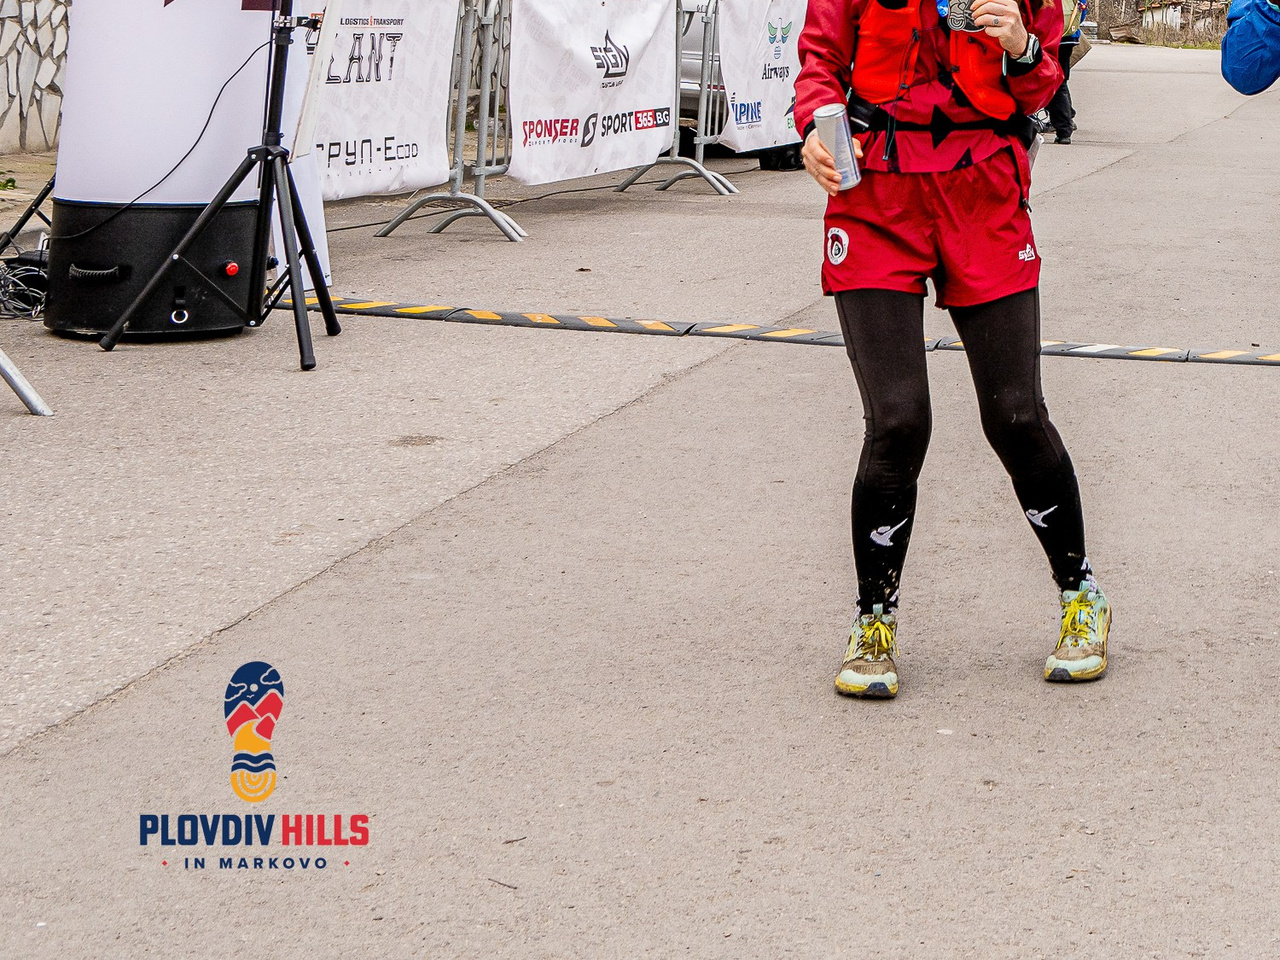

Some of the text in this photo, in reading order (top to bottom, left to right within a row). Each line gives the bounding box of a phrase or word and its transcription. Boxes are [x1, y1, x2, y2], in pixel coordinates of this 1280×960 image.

[340, 17, 370, 26] LOGSTICS
[762, 63, 790, 82] Airways
[522, 118, 580, 148] SPONSER
